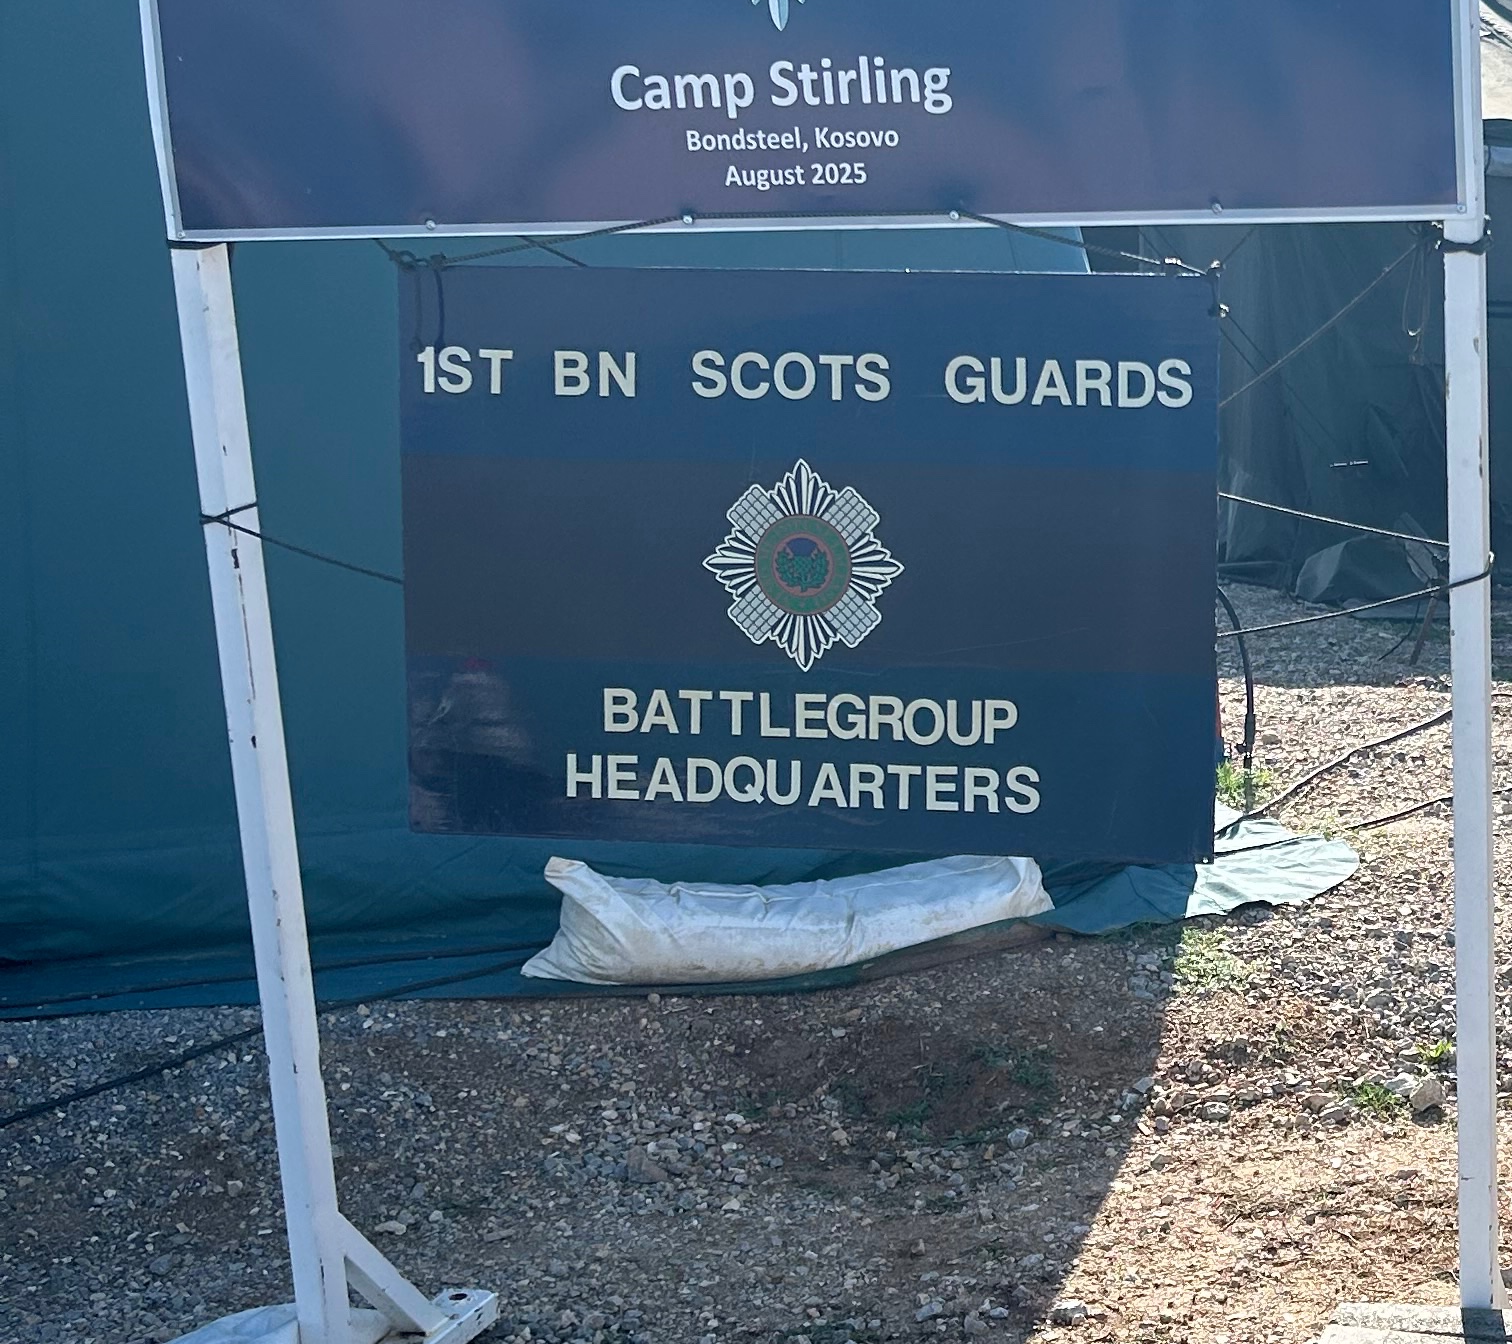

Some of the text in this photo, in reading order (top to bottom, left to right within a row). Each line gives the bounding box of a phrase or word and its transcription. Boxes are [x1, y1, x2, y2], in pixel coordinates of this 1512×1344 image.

[609, 55, 954, 119] Camp Stirling
[685, 126, 900, 154] Bondsteel, Kosovo
[724, 162, 868, 192] August 2025
[416, 345, 1194, 409] 1ST BN SCOTS GUARDS
[602, 686, 1020, 747] BATTLEGROUP
[565, 752, 1041, 815] HEADQUARTERS
